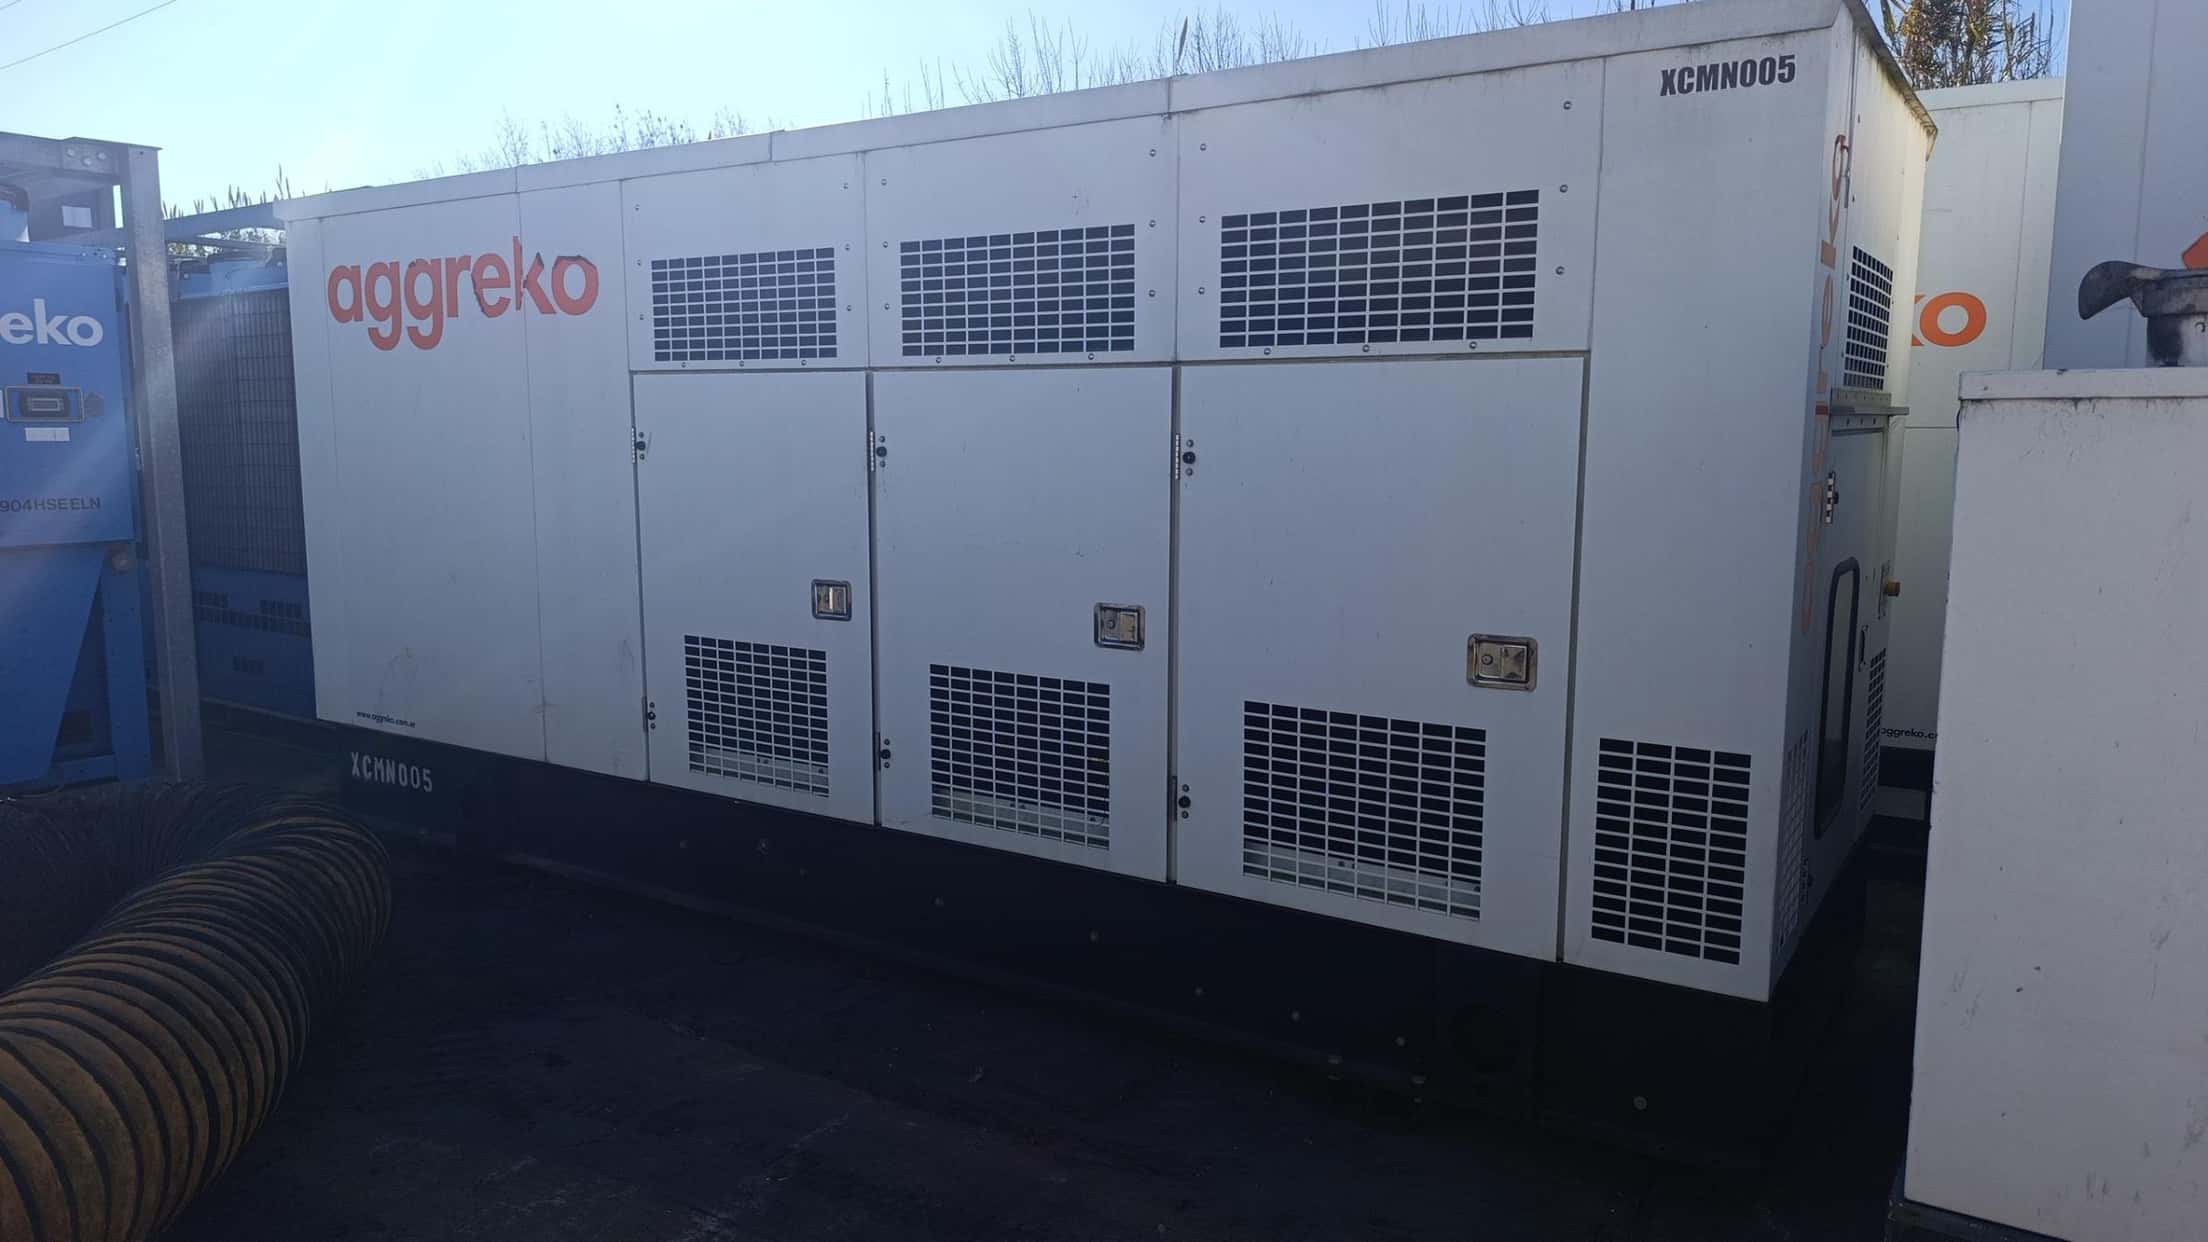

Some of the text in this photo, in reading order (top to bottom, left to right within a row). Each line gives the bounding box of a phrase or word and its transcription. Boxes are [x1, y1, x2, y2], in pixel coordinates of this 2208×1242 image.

[1660, 54, 1796, 97] XCMN005
[327, 236, 598, 351] aggreko
[0, 298, 104, 347] eko
[351, 751, 433, 793] XCMN005
